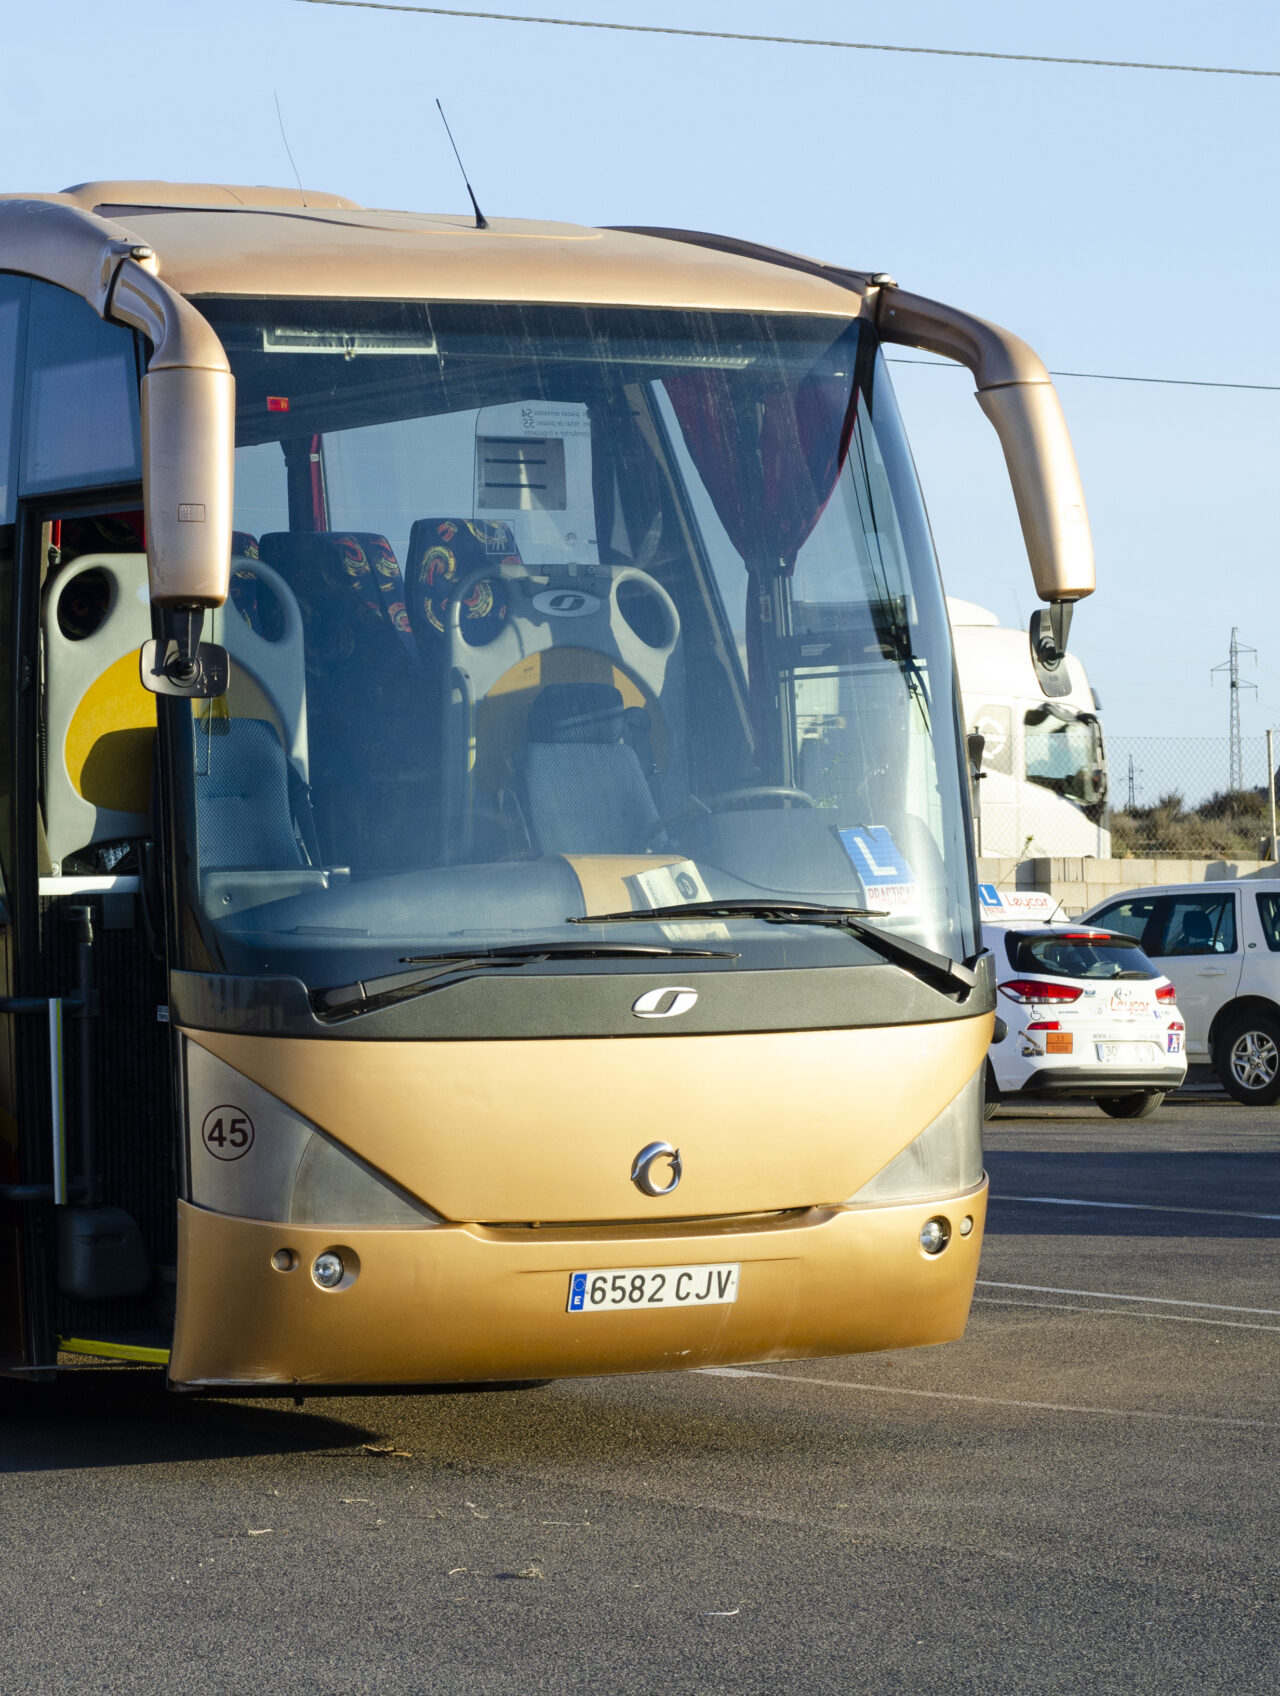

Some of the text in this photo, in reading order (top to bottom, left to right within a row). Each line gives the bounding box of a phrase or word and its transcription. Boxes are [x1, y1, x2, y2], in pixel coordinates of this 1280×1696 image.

[853, 836, 898, 877] L
[980, 886, 998, 904] L
[1004, 894, 1049, 910] Leycar
[207, 1118, 249, 1147] 45
[574, 1270, 733, 1305] E 6582 CJV
